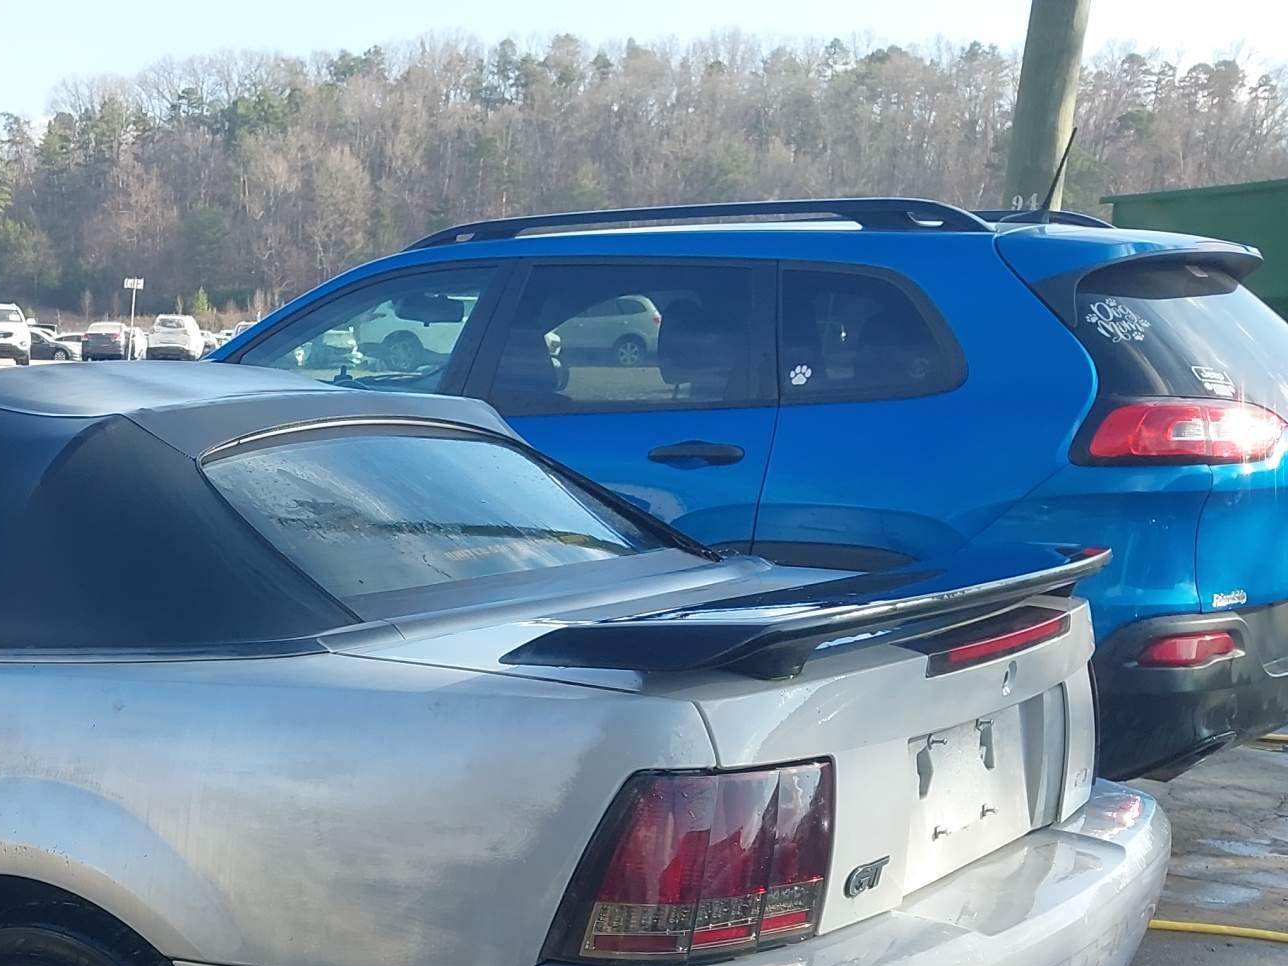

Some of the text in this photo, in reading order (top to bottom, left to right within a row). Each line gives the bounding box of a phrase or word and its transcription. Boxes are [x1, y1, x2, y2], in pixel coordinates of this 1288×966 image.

[1089, 300, 1139, 324] Dog
[1095, 315, 1143, 343] Mom
[843, 855, 890, 899] GT
